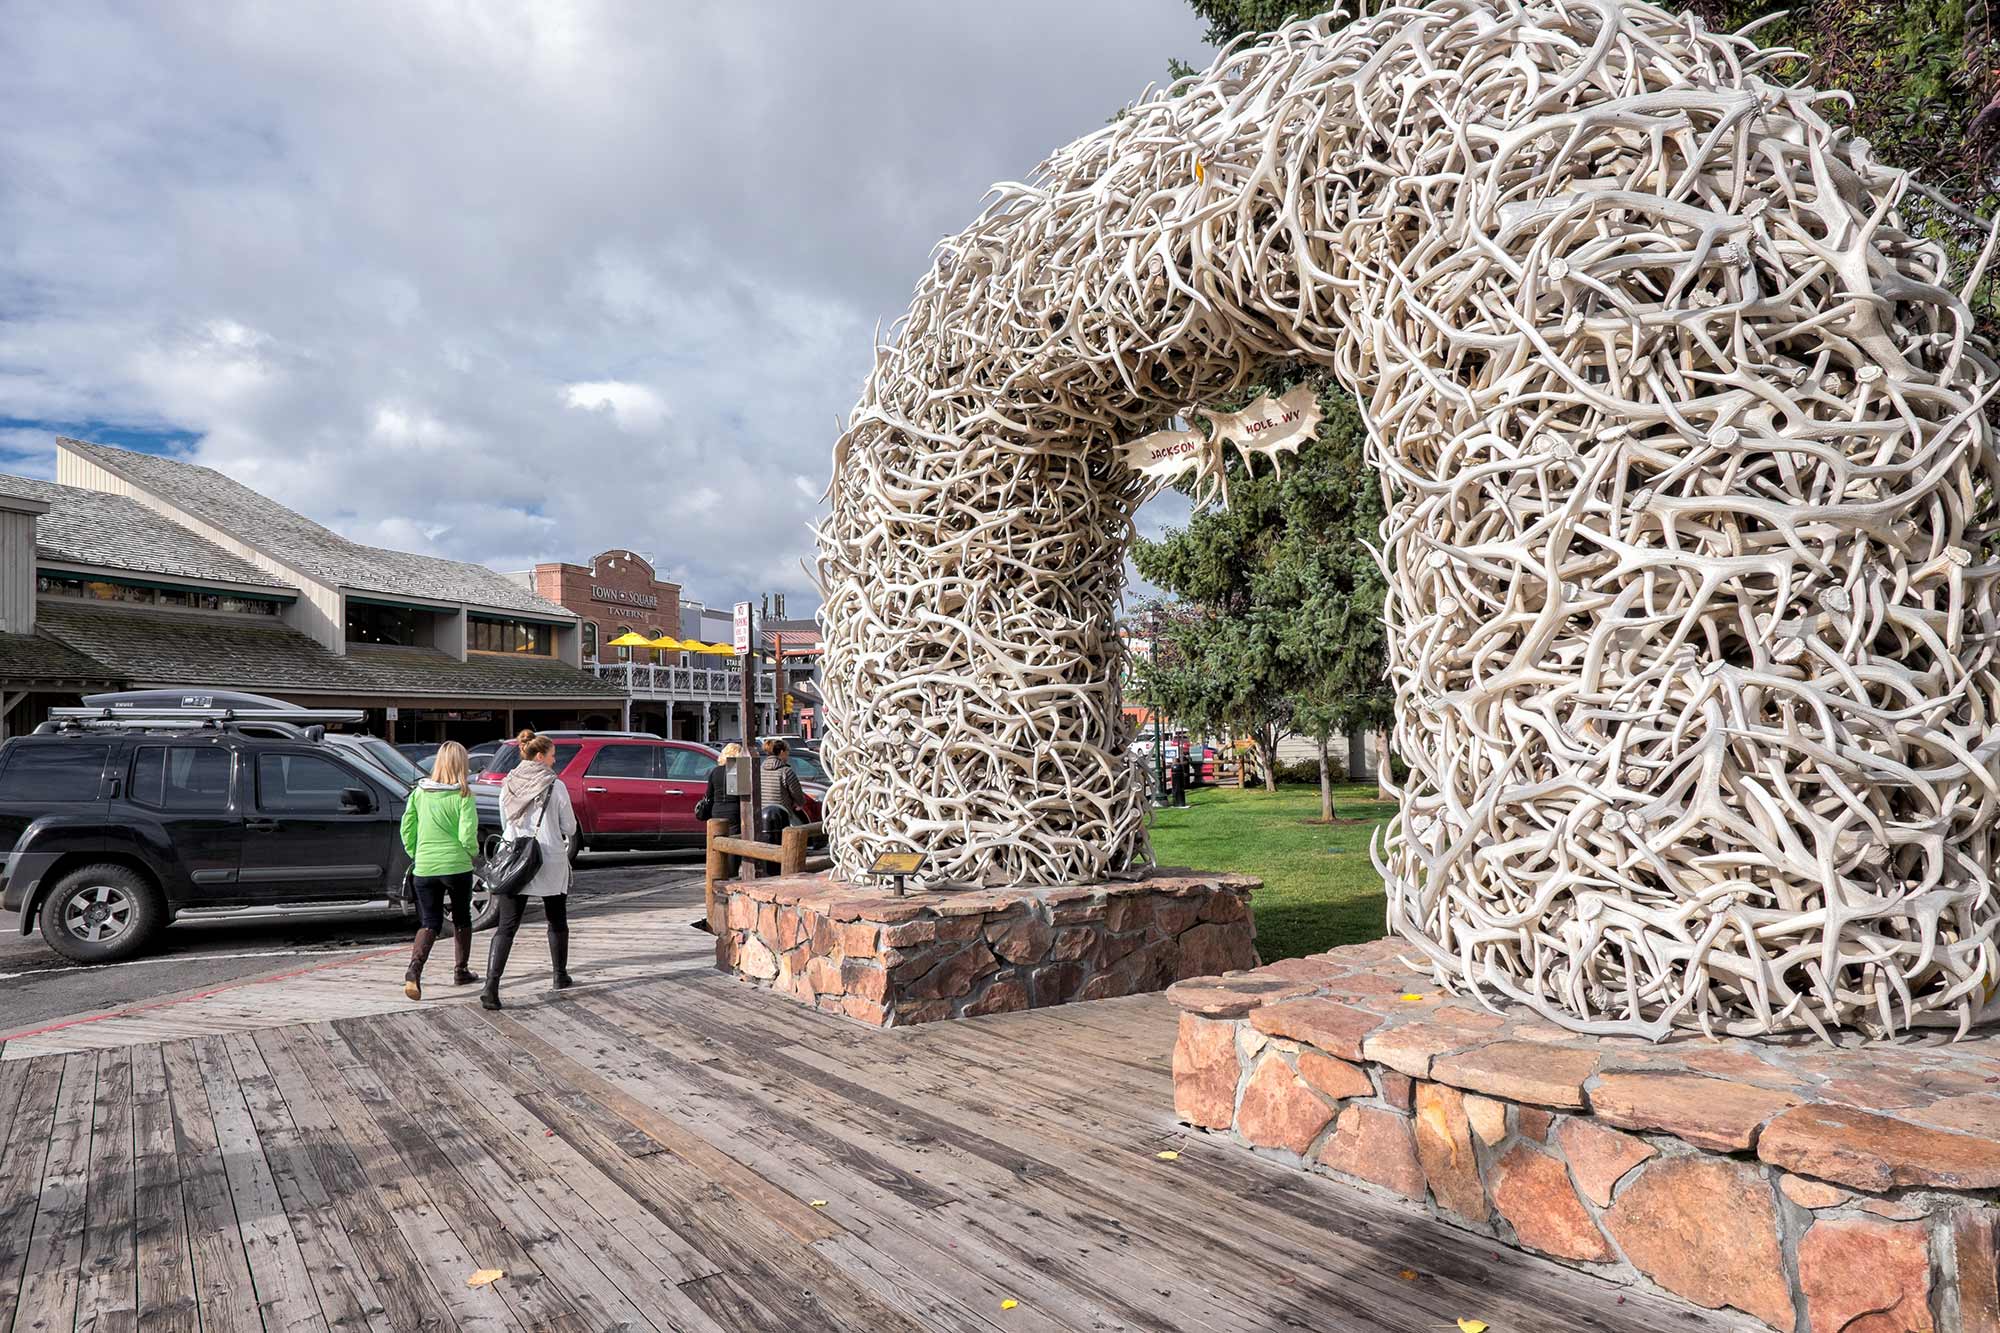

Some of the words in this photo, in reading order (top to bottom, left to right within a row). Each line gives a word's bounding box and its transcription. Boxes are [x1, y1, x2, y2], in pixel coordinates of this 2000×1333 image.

[1281, 409, 1300, 425] WY
[1151, 441, 1195, 460] JACKSON
[590, 584, 618, 600] TOWN
[628, 591, 657, 607] SQUARE
[608, 607, 644, 618] TAVERN
